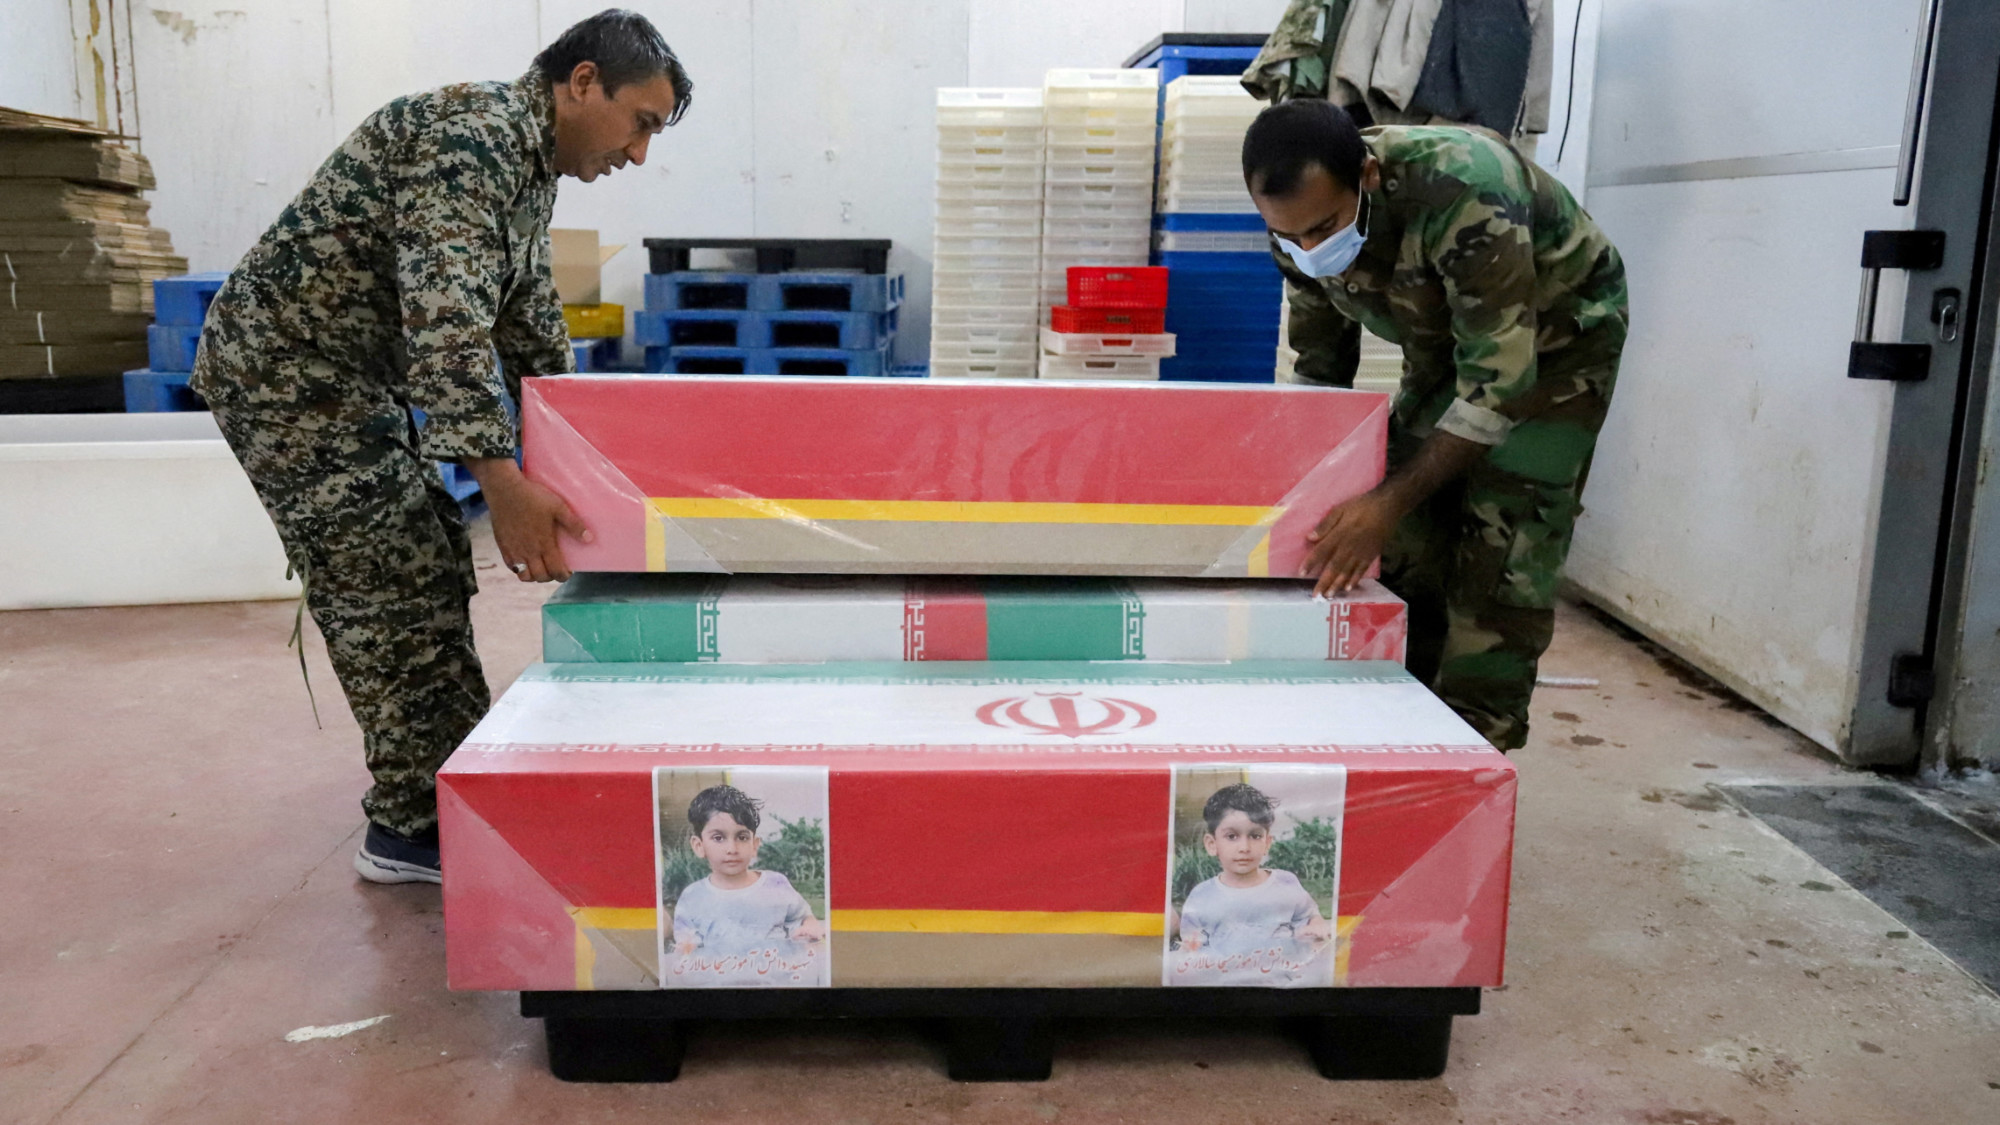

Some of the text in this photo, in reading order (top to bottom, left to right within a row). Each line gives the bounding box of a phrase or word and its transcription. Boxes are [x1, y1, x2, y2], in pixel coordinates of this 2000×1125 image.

[731, 950, 759, 970] آموز
[757, 948, 786, 975] دانش
[788, 950, 815, 980] شهید
